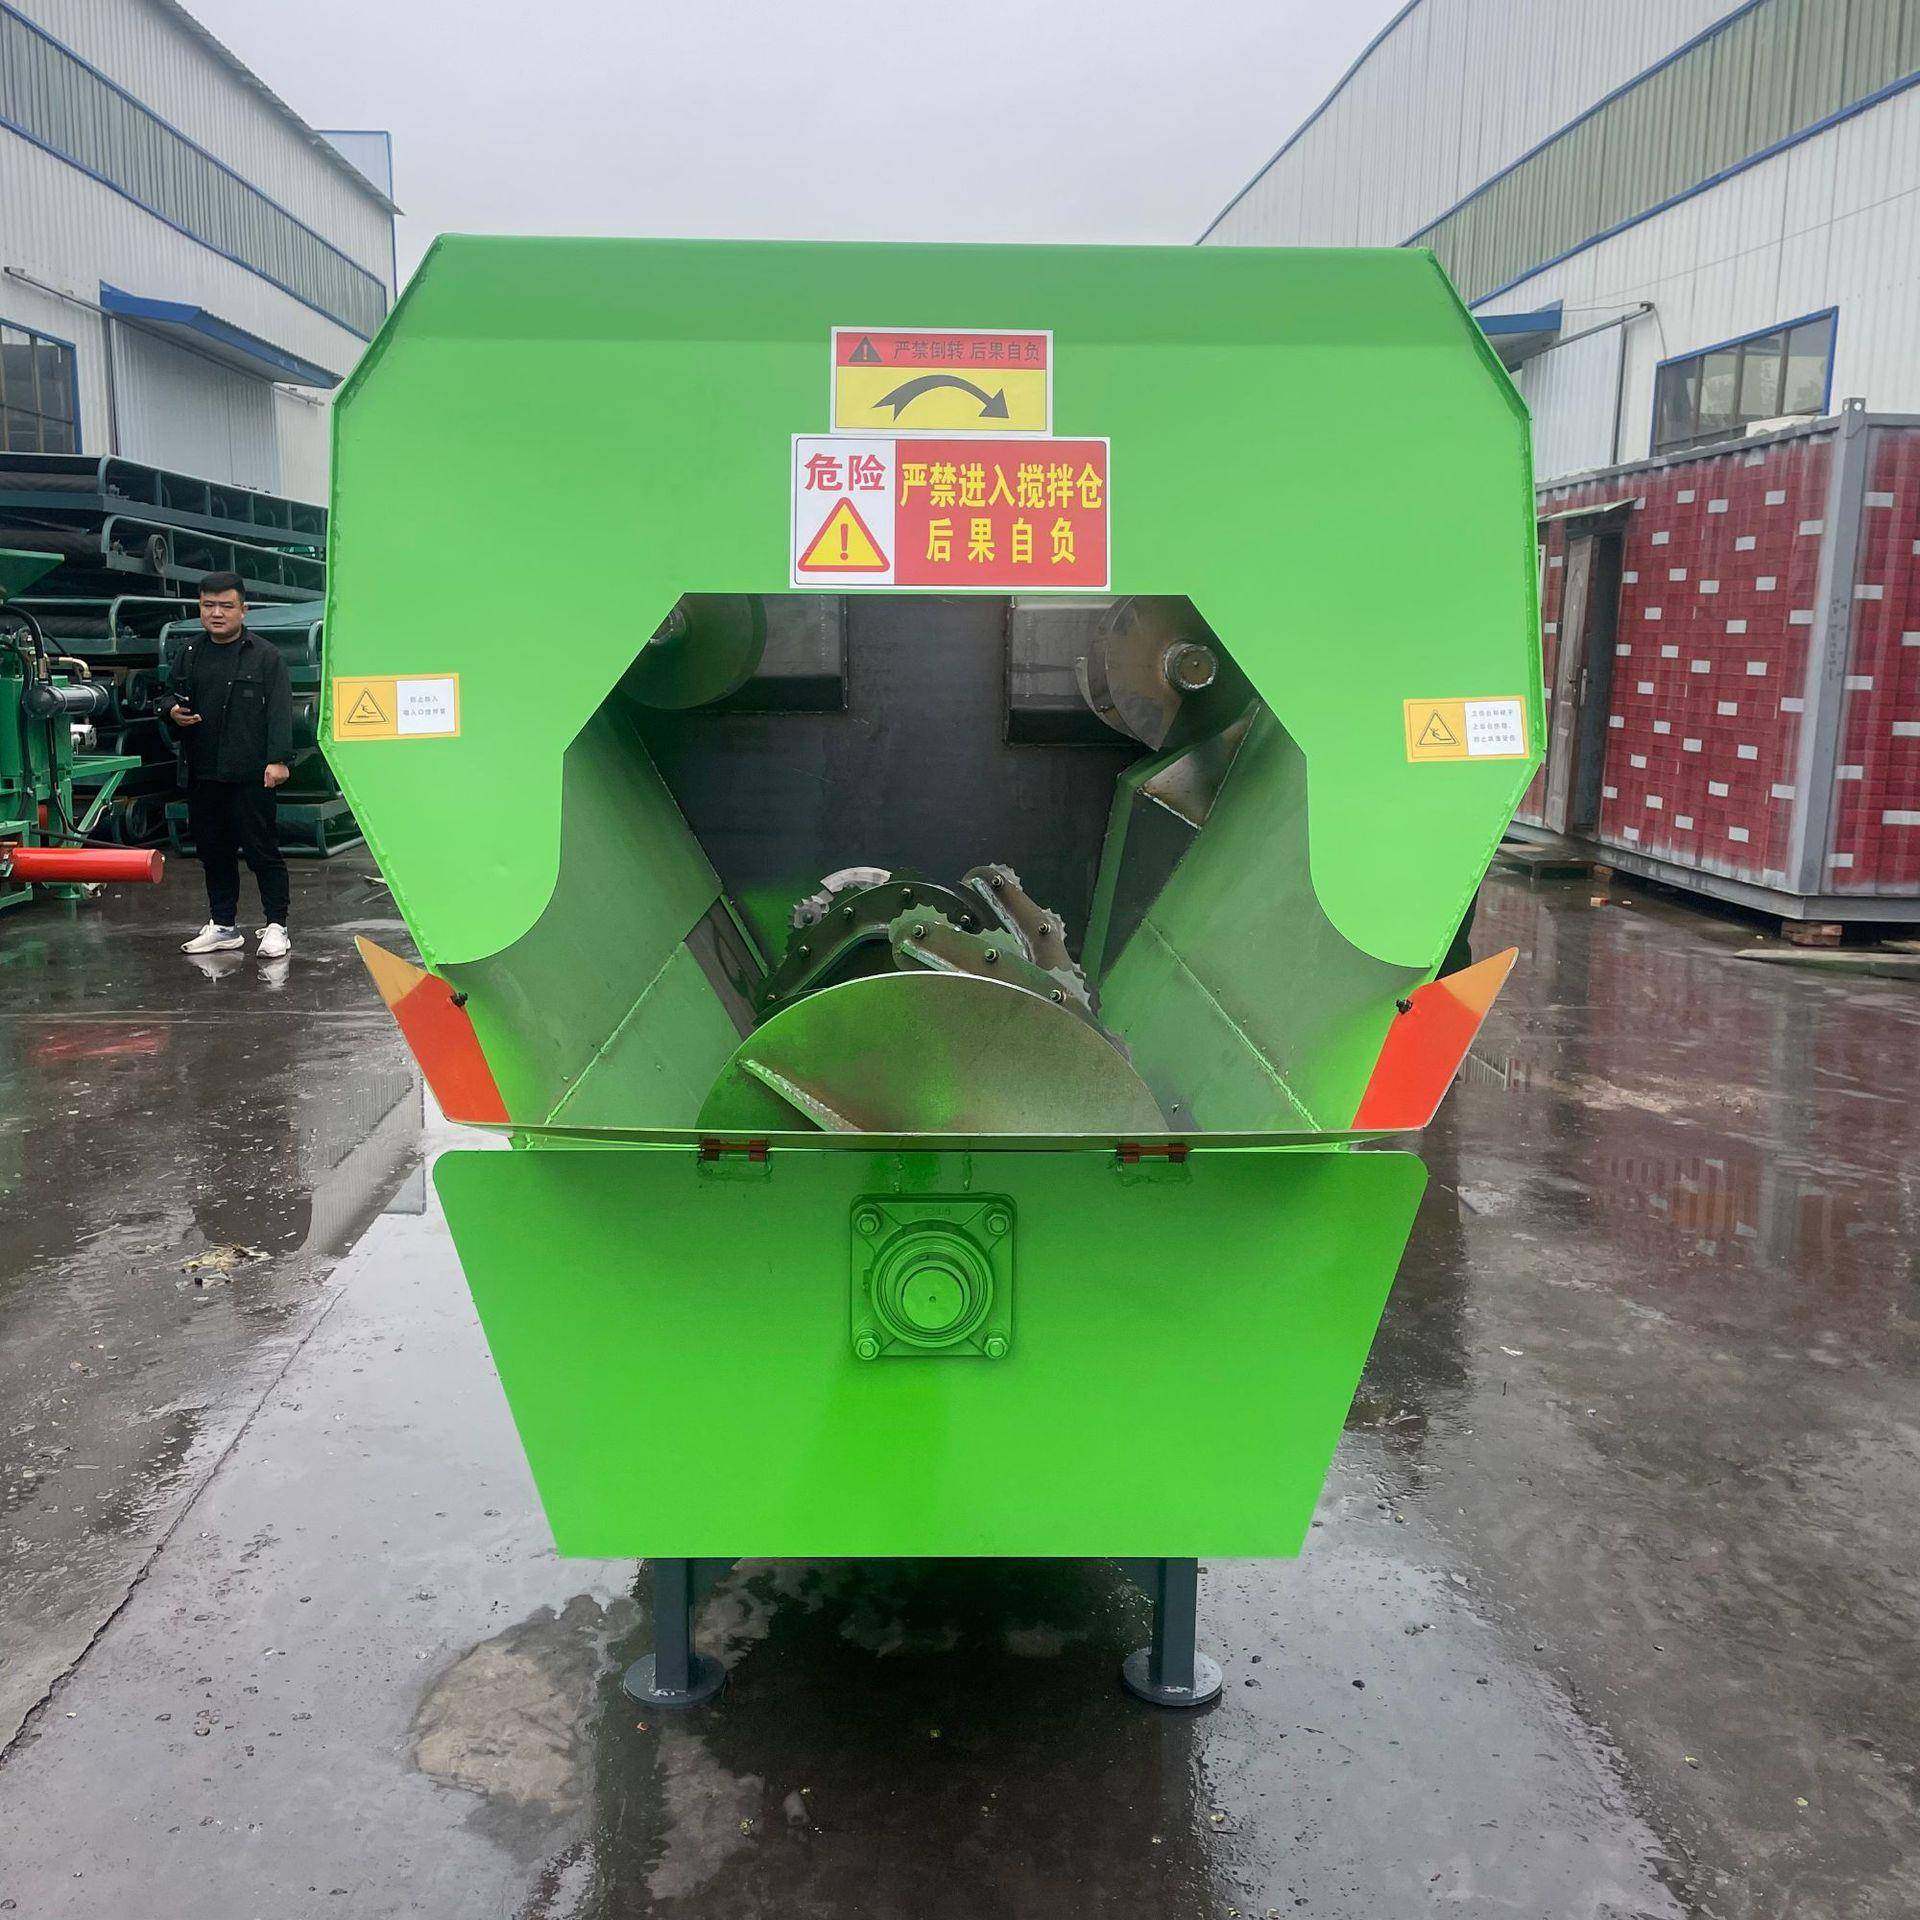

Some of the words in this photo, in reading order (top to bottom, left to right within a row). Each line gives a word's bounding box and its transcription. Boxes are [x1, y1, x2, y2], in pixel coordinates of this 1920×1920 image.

[893, 341, 963, 360] 严禁倒转
[970, 342, 1040, 362] 后果自负
[804, 453, 887, 492] 危险
[900, 462, 1103, 509] 严禁进入搅拌仓
[926, 517, 1077, 564] 后果自负
